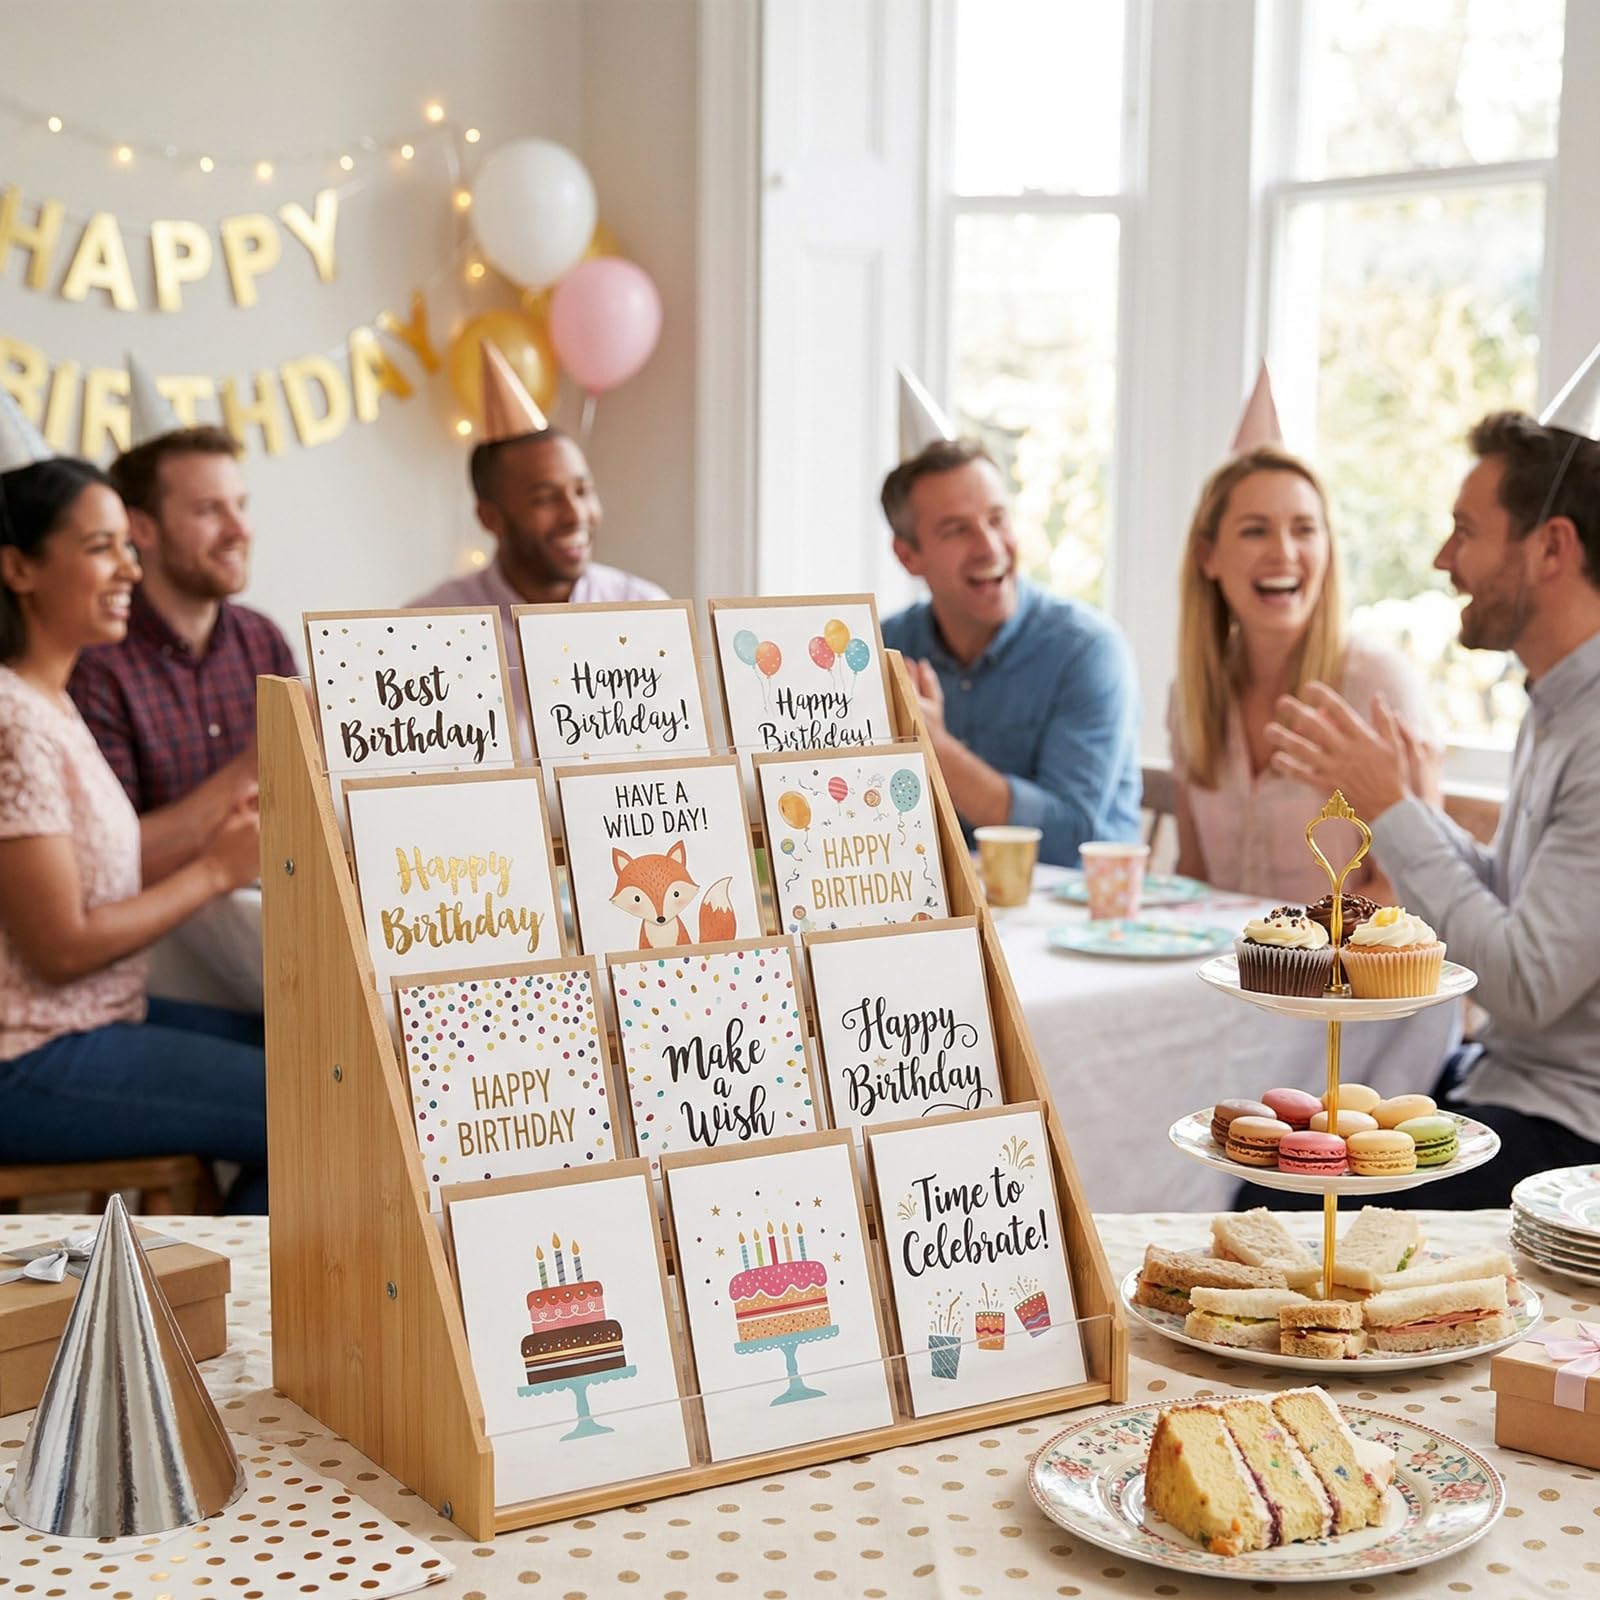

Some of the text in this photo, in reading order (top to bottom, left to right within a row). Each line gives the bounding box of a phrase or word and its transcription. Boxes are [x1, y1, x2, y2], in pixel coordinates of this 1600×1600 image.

[0, 182, 338, 312] HAPPY
[375, 665, 450, 710] Best
[571, 661, 662, 699] Happy
[776, 686, 851, 720] Happy
[340, 710, 498, 764] Birthday!
[550, 699, 690, 745] Birthday!
[758, 719, 874, 752] Birthday!
[615, 781, 688, 809] HAVE A
[603, 807, 708, 839] WILD DAY!
[395, 846, 513, 897] Happy
[823, 834, 892, 870] HAPPY
[811, 871, 914, 910] BIRTHDAY
[381, 892, 544, 955] Birthday
[662, 1017, 766, 1083] Make
[842, 996, 978, 1056] Happy
[472, 1068, 551, 1111] HAPPY
[713, 1076, 732, 1099] a
[842, 1049, 994, 1118] Birthday
[457, 1107, 577, 1157] BIRTHDAY
[680, 1084, 776, 1148] Wish
[911, 1166, 1025, 1223] Time to
[902, 1208, 1050, 1279] Celebrate!
